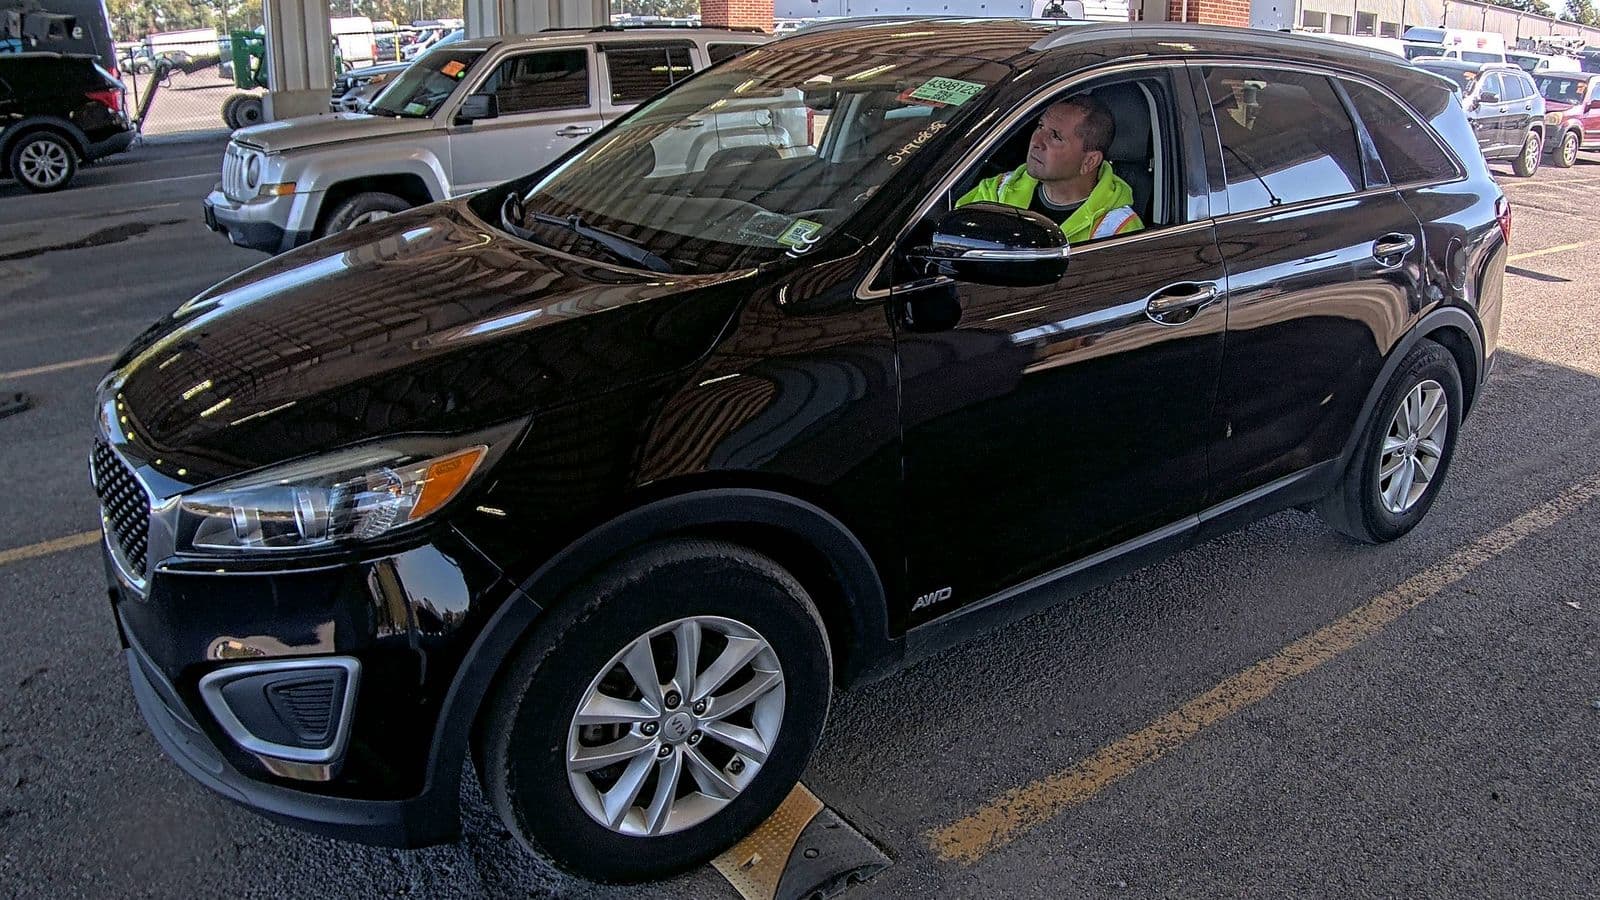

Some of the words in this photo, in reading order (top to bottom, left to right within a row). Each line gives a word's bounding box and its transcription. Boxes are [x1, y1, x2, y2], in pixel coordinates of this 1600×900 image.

[930, 78, 981, 95] 4398123
[911, 586, 952, 612] AWD
[671, 716, 688, 736] KIA
